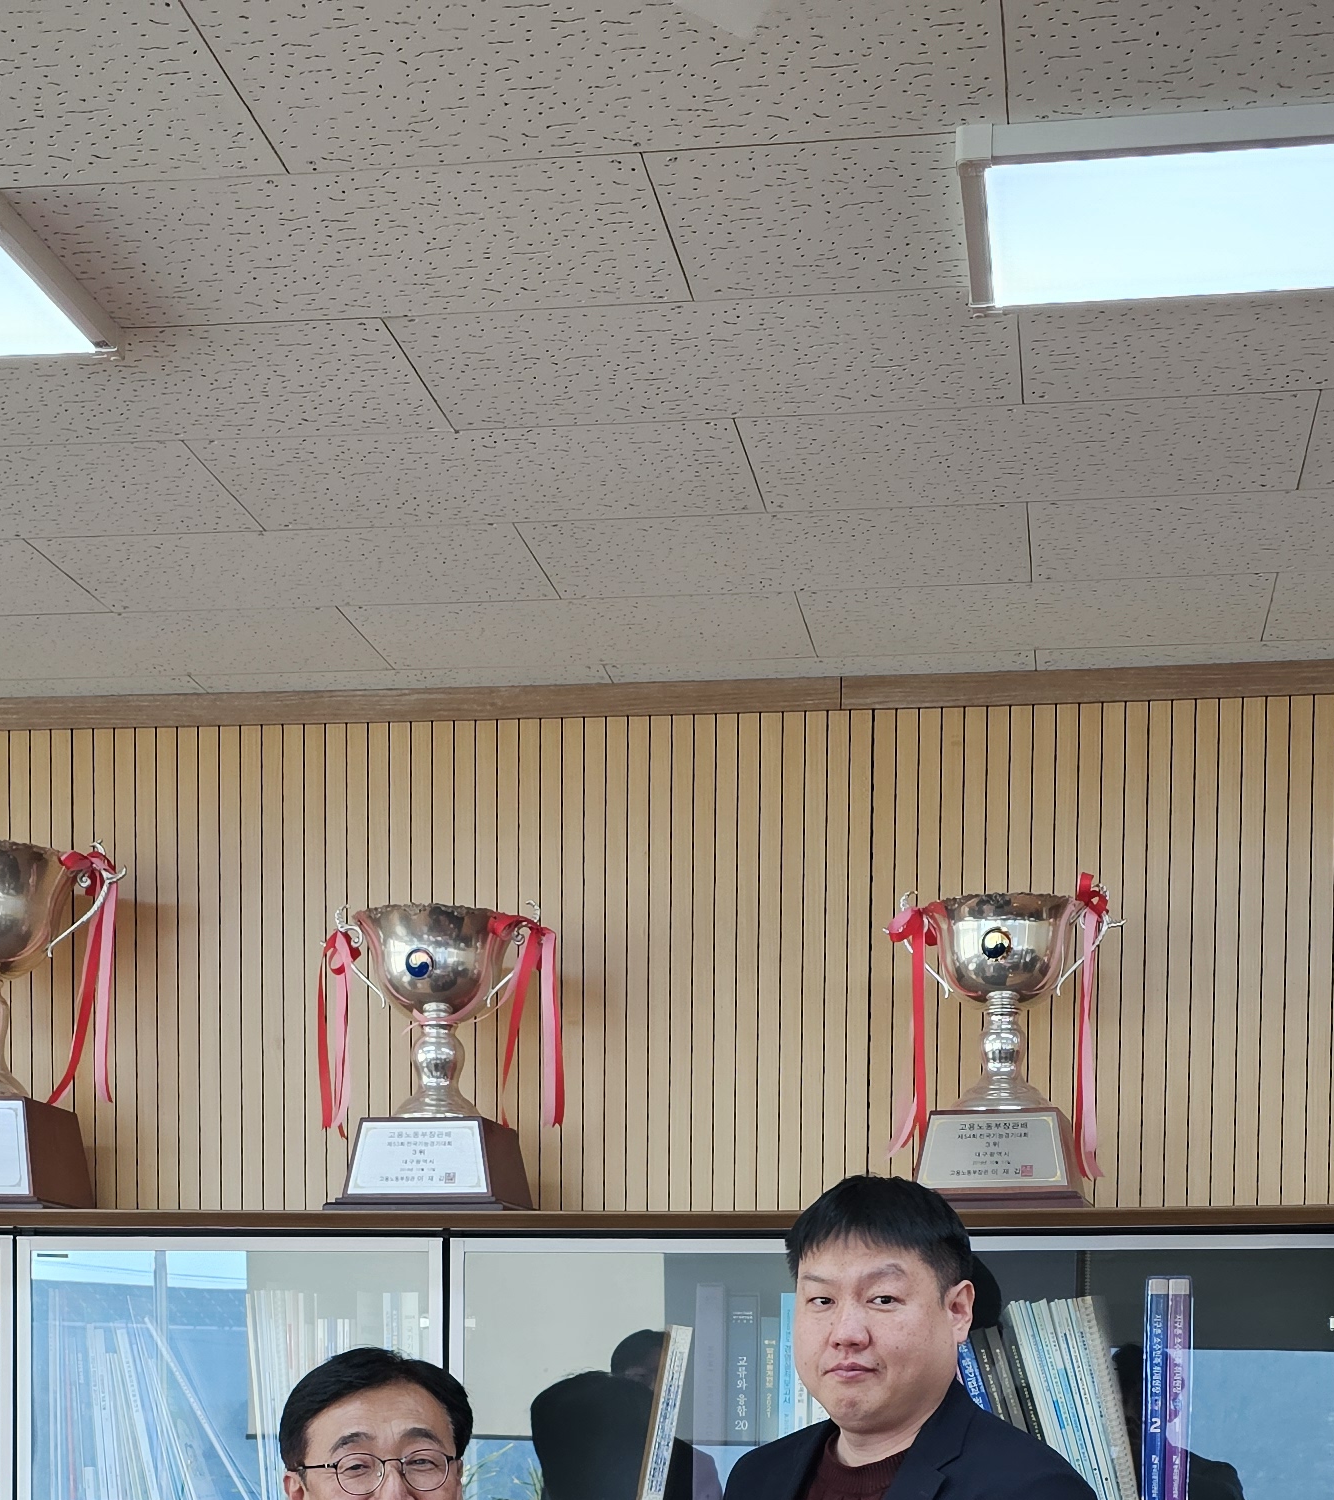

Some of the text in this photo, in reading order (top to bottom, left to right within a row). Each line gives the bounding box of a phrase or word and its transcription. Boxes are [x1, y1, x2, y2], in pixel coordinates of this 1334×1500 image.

[958, 1122, 1029, 1131] 고용노동부장관배
[734, 1356, 748, 1430] 교류와 융합 20
[1149, 1417, 1161, 1433] 2
